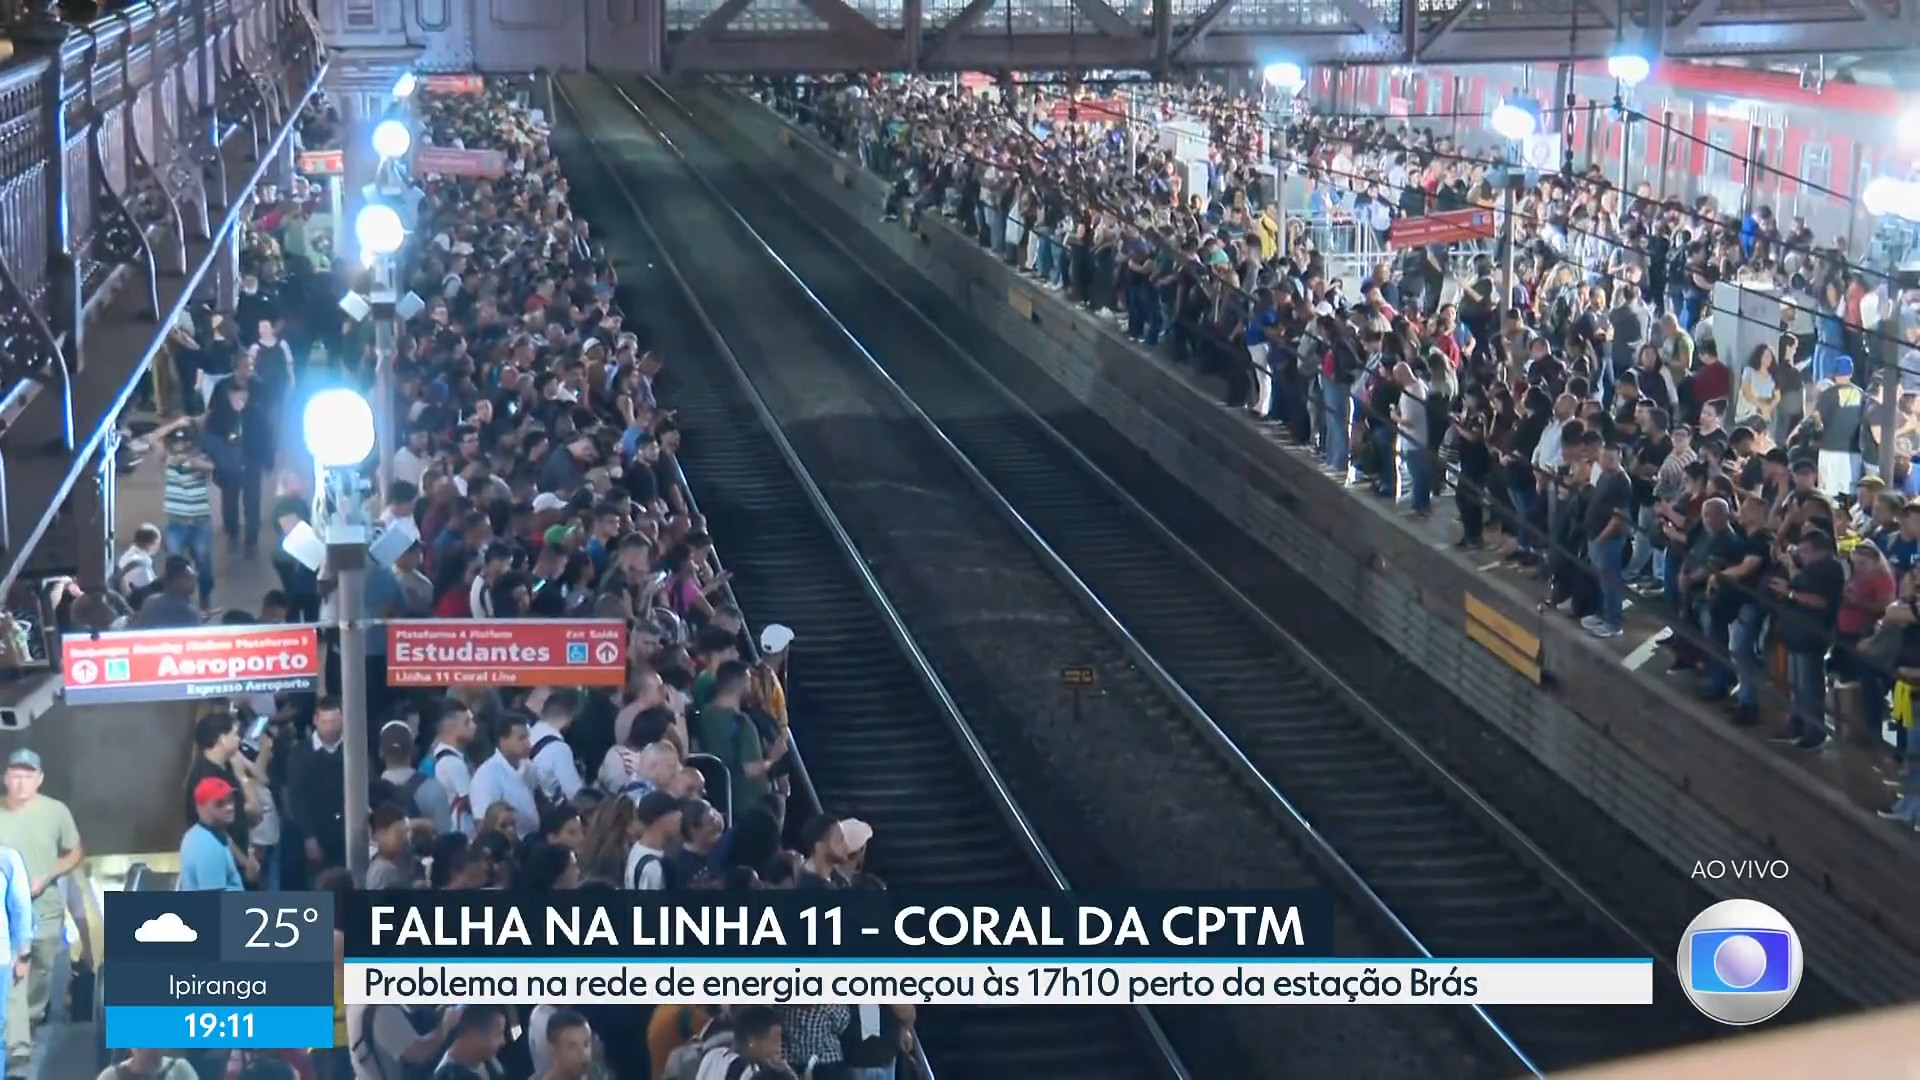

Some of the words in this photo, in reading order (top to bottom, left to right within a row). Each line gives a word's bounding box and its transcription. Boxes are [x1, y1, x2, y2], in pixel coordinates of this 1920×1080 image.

[395, 642, 550, 662] Estudantes
[158, 651, 308, 678] Aeroporto
[396, 671, 432, 683] Linha
[436, 671, 450, 683] 11
[454, 671, 488, 683] Coral
[491, 671, 517, 683] Line
[186, 682, 243, 697] Expresso
[245, 679, 311, 694] Aeroporto
